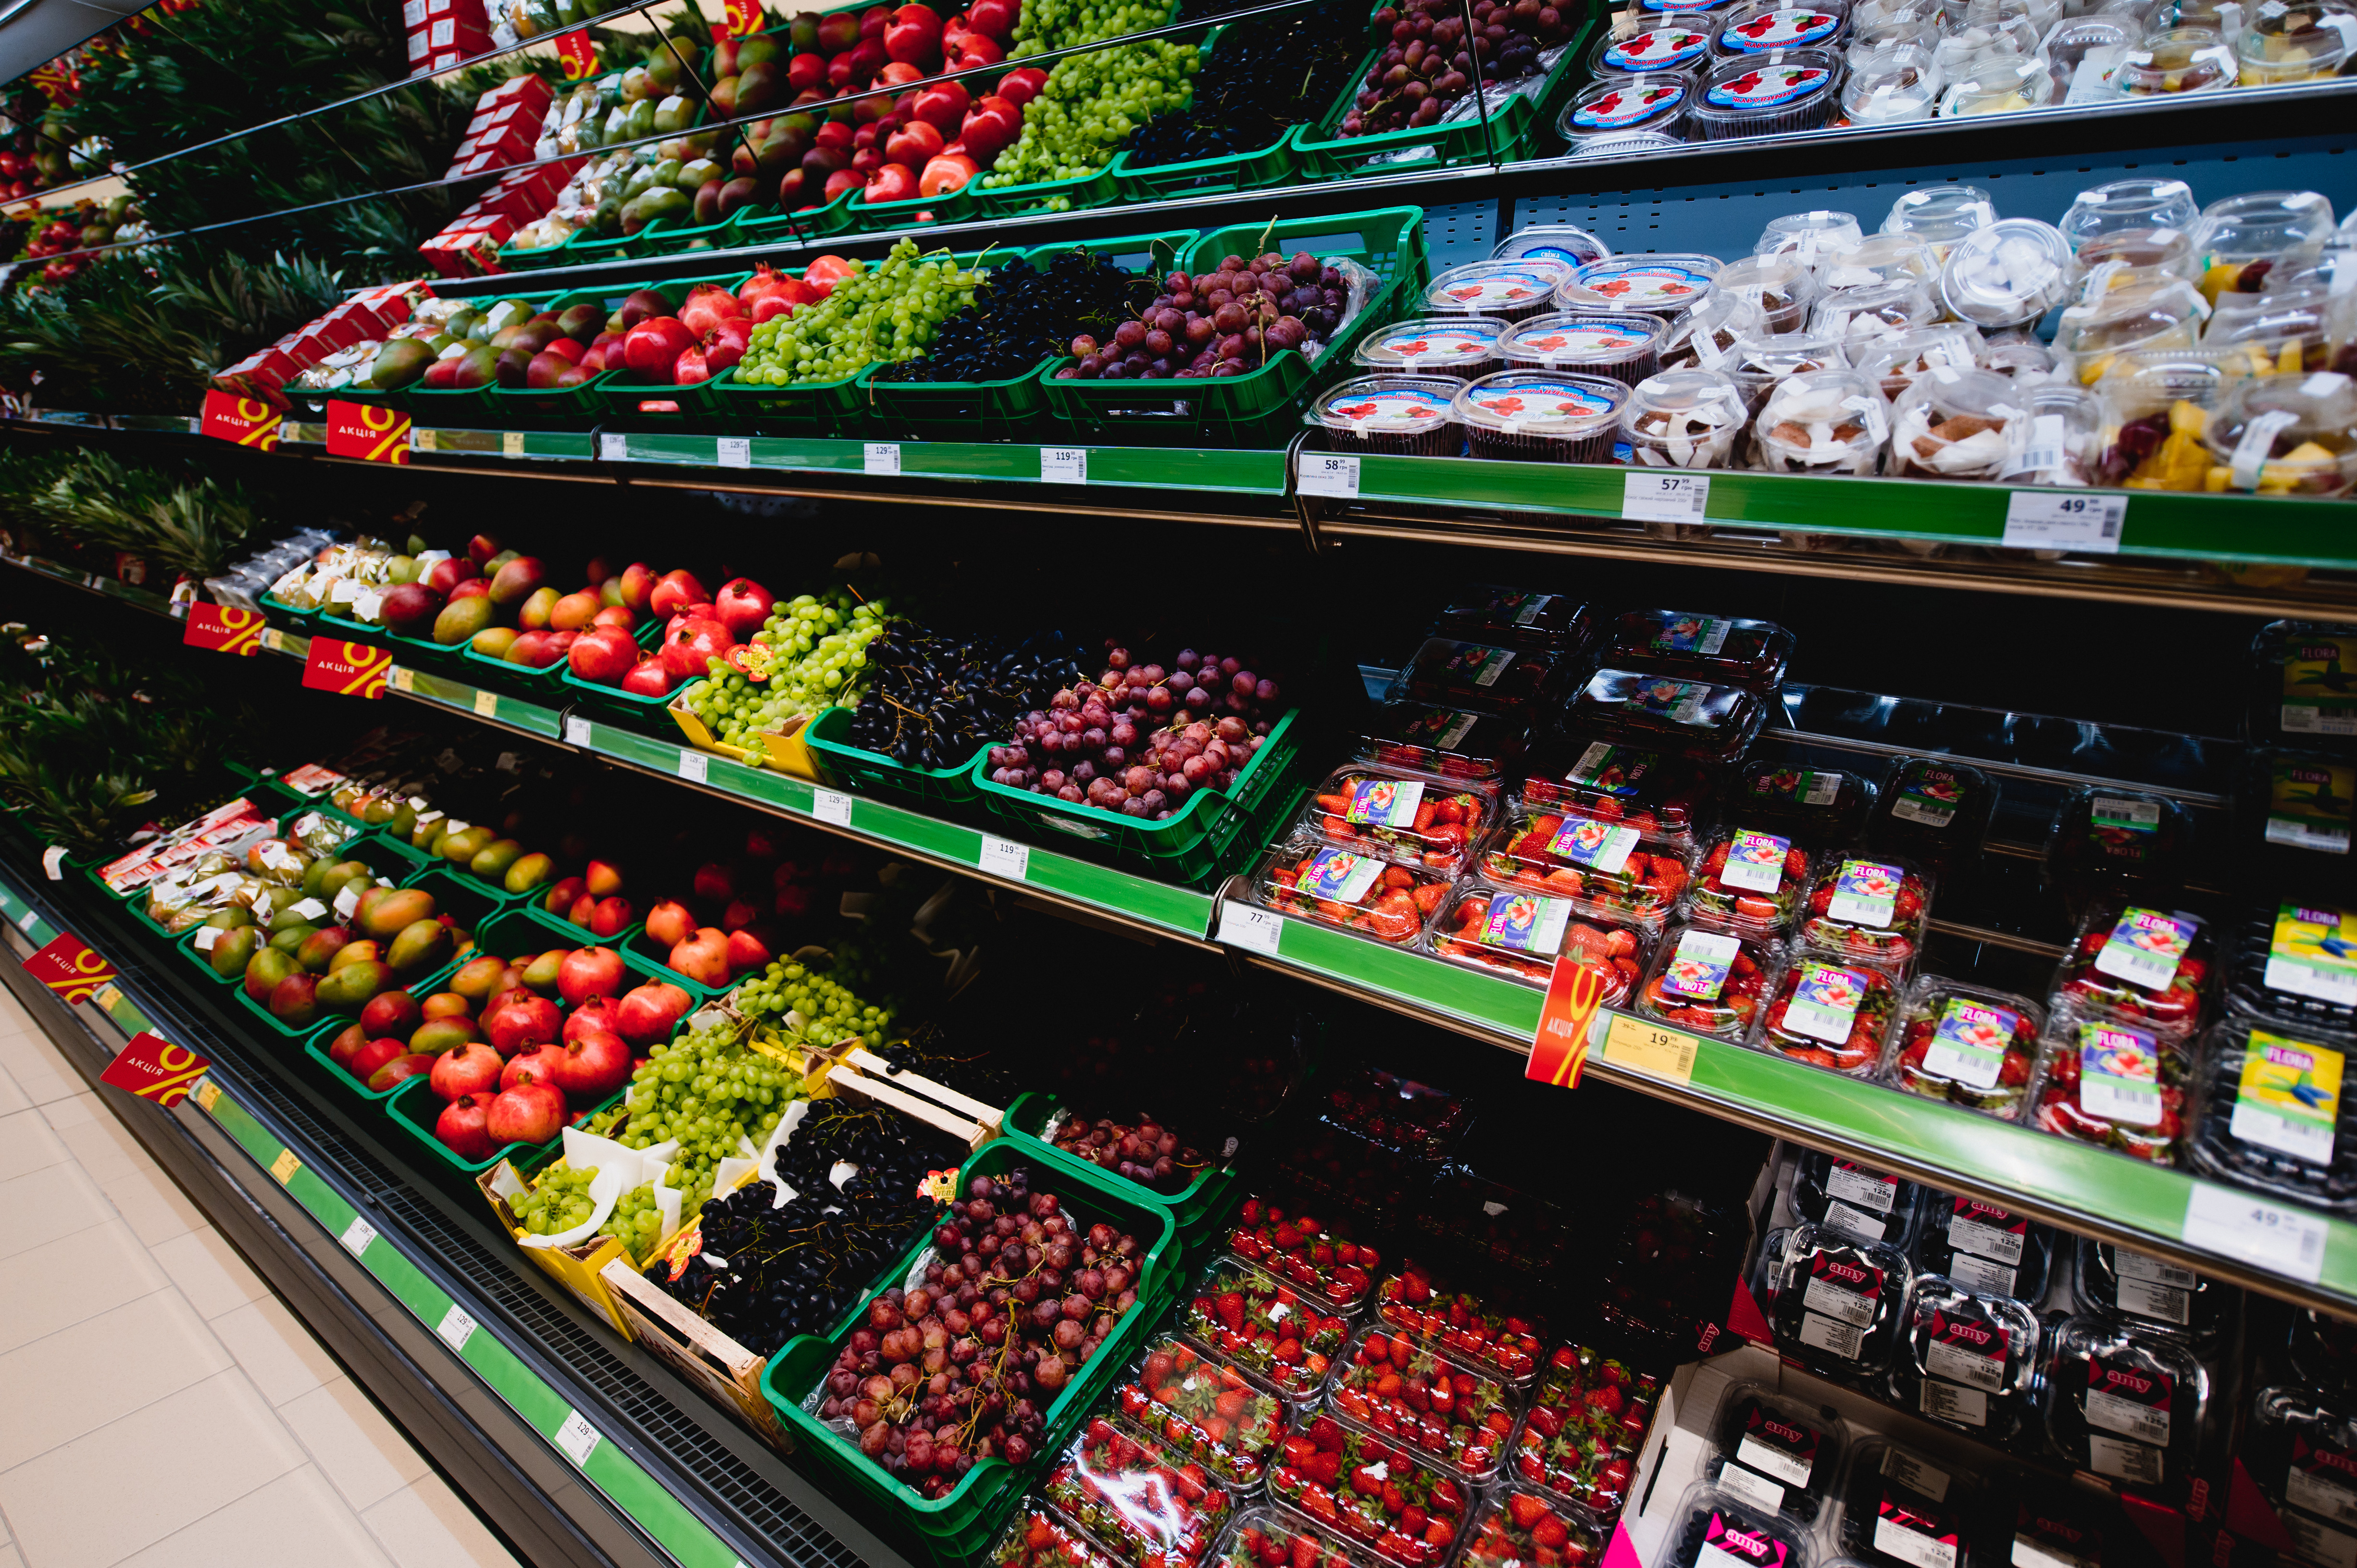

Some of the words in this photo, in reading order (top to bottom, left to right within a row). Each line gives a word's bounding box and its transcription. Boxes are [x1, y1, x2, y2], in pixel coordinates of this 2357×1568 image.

[1540, 250, 1560, 259] свіжа
[1475, 278, 1533, 287] ЖУРАВЛИНА
[1616, 272, 1686, 280] ЖУРАВЛИНА
[1416, 333, 1480, 341] ЖУРАВЛИНА
[1551, 328, 1624, 336] ЖУРАВЛИНА
[1364, 395, 1432, 404] ЖУРАВЛИНА
[1506, 389, 1583, 401] ЖУРАВЛИНА
[215, 413, 250, 428] АКЦІЯ
[338, 425, 376, 438] АКЦІЯ
[876, 446, 887, 454] 129
[1056, 452, 1070, 460] 119
[1325, 460, 1338, 470] 58
[1661, 479, 1680, 490] 57
[2059, 498, 2085, 513] 49
[1485, 599, 1499, 611] FLORA
[197, 622, 231, 634] АКЦІЯ
[1659, 628, 1673, 641] FLORA
[2301, 647, 2337, 660] FLORA
[317, 660, 355, 674] АКЦІЯ
[1446, 656, 1463, 669] FLORA
[1635, 690, 1650, 705] FLORA
[1406, 721, 1422, 734] FLORA
[1628, 761, 1647, 780] FLORA
[1925, 770, 1955, 782] FLORA
[2291, 770, 2330, 783] FLORA
[1756, 775, 1771, 793] FLORA
[829, 795, 840, 804] 129
[1354, 797, 1370, 815] FLORA
[1556, 833, 1575, 851] FLORA
[1746, 836, 1774, 847] FLORA
[1000, 844, 1014, 854] 119
[2106, 846, 2141, 858] FLORA
[1308, 863, 1326, 883] FLORA
[1855, 865, 1886, 877] FLORA
[1250, 912, 1263, 923] 77
[2139, 913, 2175, 932] FLORA
[2297, 908, 2340, 926] FLORA
[1490, 914, 1507, 935] FLORA
[48, 952, 77, 974] АКЦІЯ
[1816, 970, 1850, 985] FLORA
[1678, 980, 1709, 993] FLORA
[1962, 1005, 1997, 1025] FLORA
[1546, 1016, 1574, 1039] АКЦІЯ
[1650, 1033, 1668, 1045] 19
[2097, 1029, 2137, 1049] FLORA
[2268, 1046, 2313, 1069] FLORA
[126, 1057, 164, 1076] АКЦІЯ
[1873, 1187, 1891, 1198] 125g
[2250, 1208, 2279, 1226] 49
[2001, 1238, 2021, 1249] 125g
[1829, 1262, 1866, 1282] amy
[1854, 1302, 1872, 1314] 125g
[457, 1314, 467, 1325] 129
[1949, 1322, 1991, 1344] amy
[1980, 1365, 2002, 1378] 125g
[2107, 1369, 2152, 1394] amy
[577, 1421, 589, 1435] 129
[1764, 1420, 1803, 1442] amy
[1725, 1529, 1769, 1557] amy
